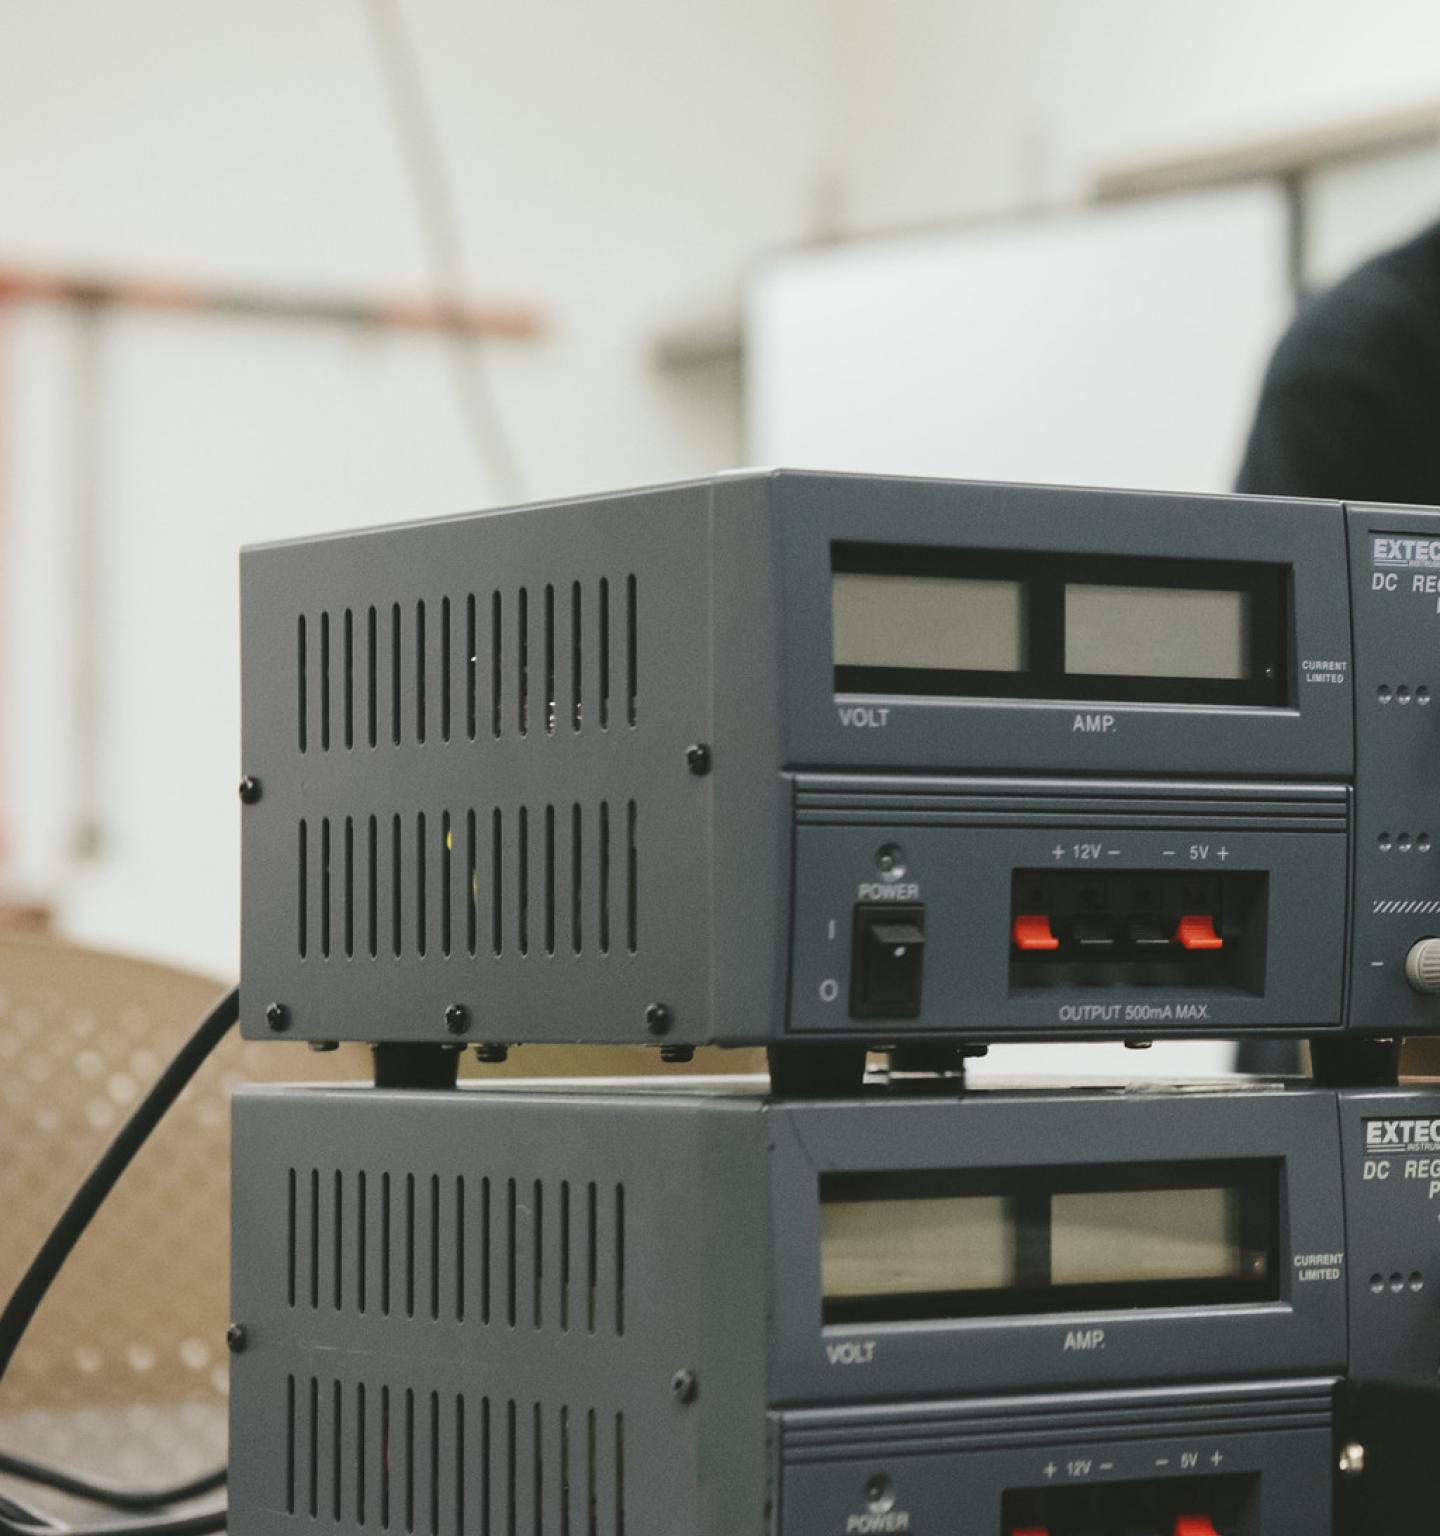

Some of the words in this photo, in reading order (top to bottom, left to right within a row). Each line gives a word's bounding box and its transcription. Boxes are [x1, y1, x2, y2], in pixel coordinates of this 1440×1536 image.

[1371, 572, 1398, 592] DC
[1302, 660, 1347, 671] CURRENT
[1306, 673, 1344, 683] LIMITED
[838, 708, 890, 727] VOLT
[1072, 714, 1117, 733] AMP.
[1072, 844, 1102, 859] 12V
[1190, 845, 1209, 860] 5V
[858, 883, 919, 900] POWER
[1059, 1005, 1121, 1021] OUTPUT
[1125, 1005, 1172, 1021] 500mA
[1363, 1161, 1391, 1180] DC
[1294, 1253, 1343, 1266] CURRENT
[1299, 1268, 1340, 1280] LIMITED
[1063, 1330, 1105, 1350] AMP.
[826, 1341, 876, 1364] VOLT
[1067, 1460, 1092, 1477] 12V
